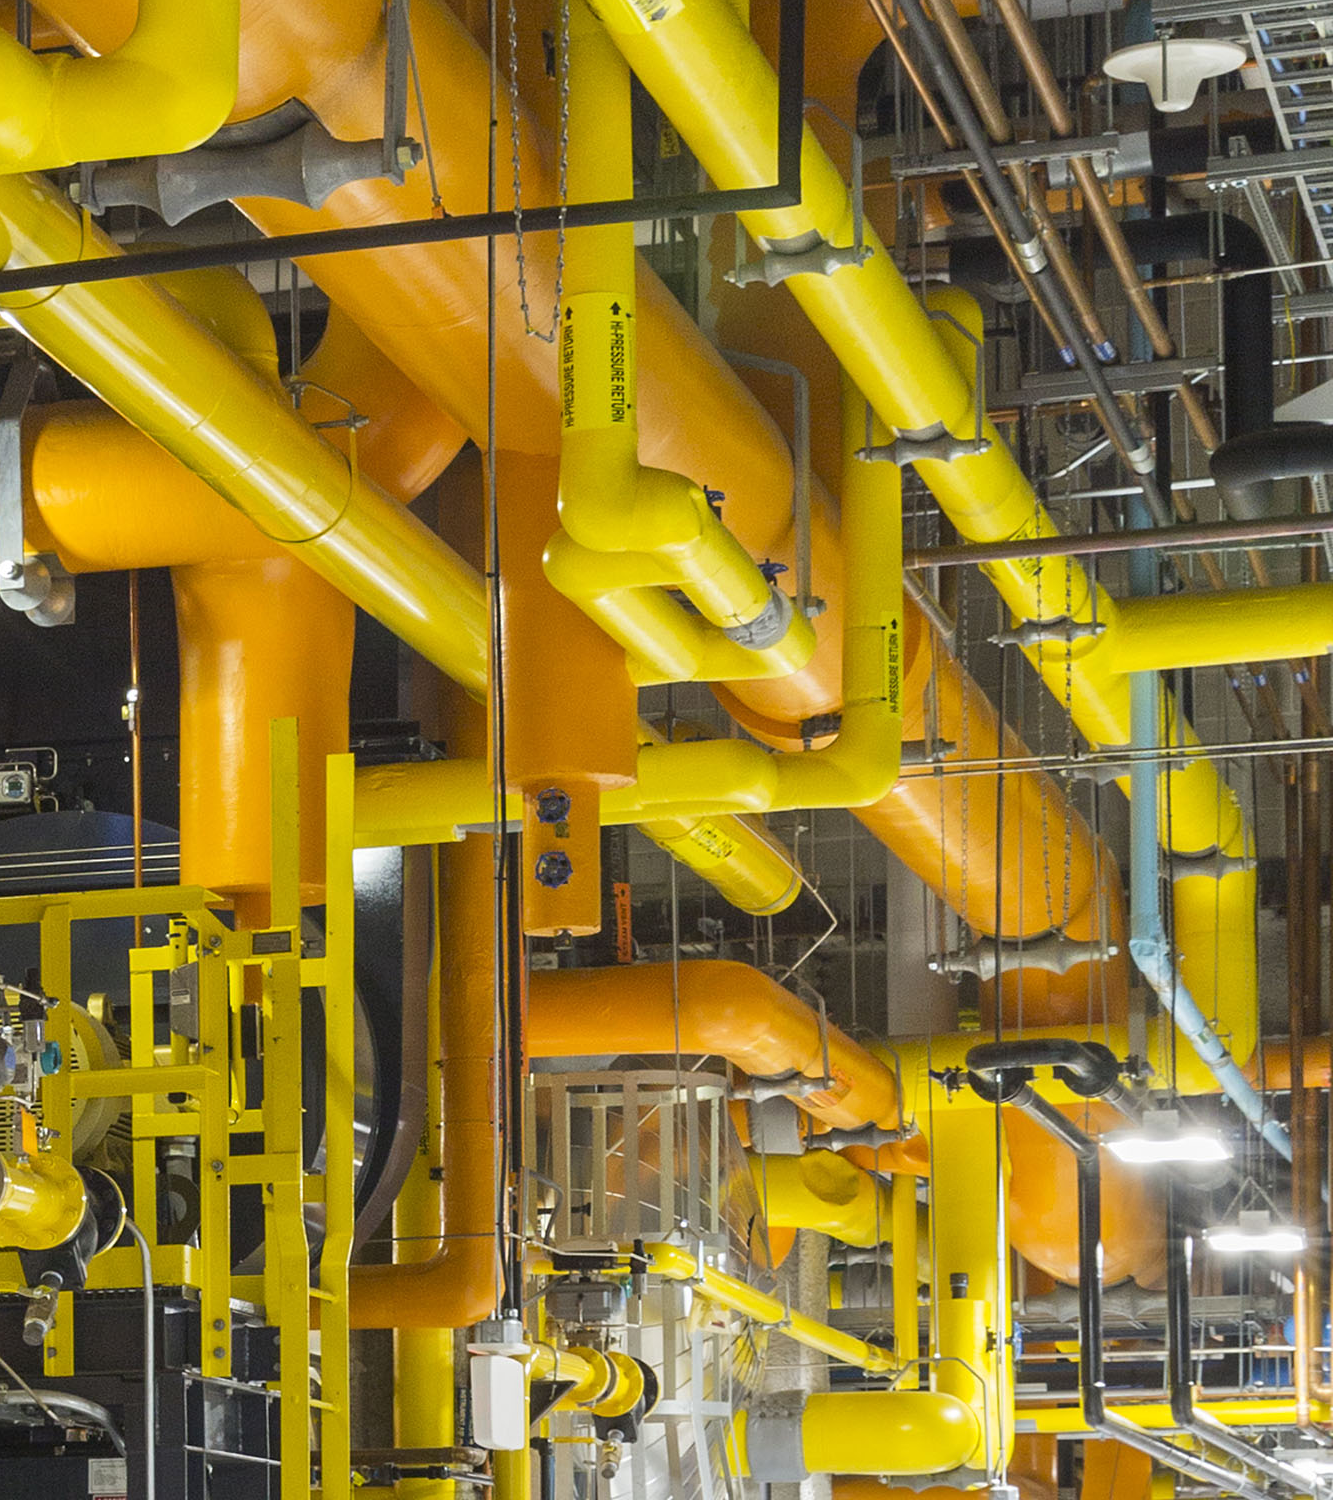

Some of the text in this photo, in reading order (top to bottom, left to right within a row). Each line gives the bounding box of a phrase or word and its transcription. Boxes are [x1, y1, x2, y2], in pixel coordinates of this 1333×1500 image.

[563, 325, 575, 428] HI-PRESSURE RETURN
[610, 320, 625, 423] HI-PRESSURE RETURN
[888, 632, 900, 714] HI-PRESSURE RETURN
